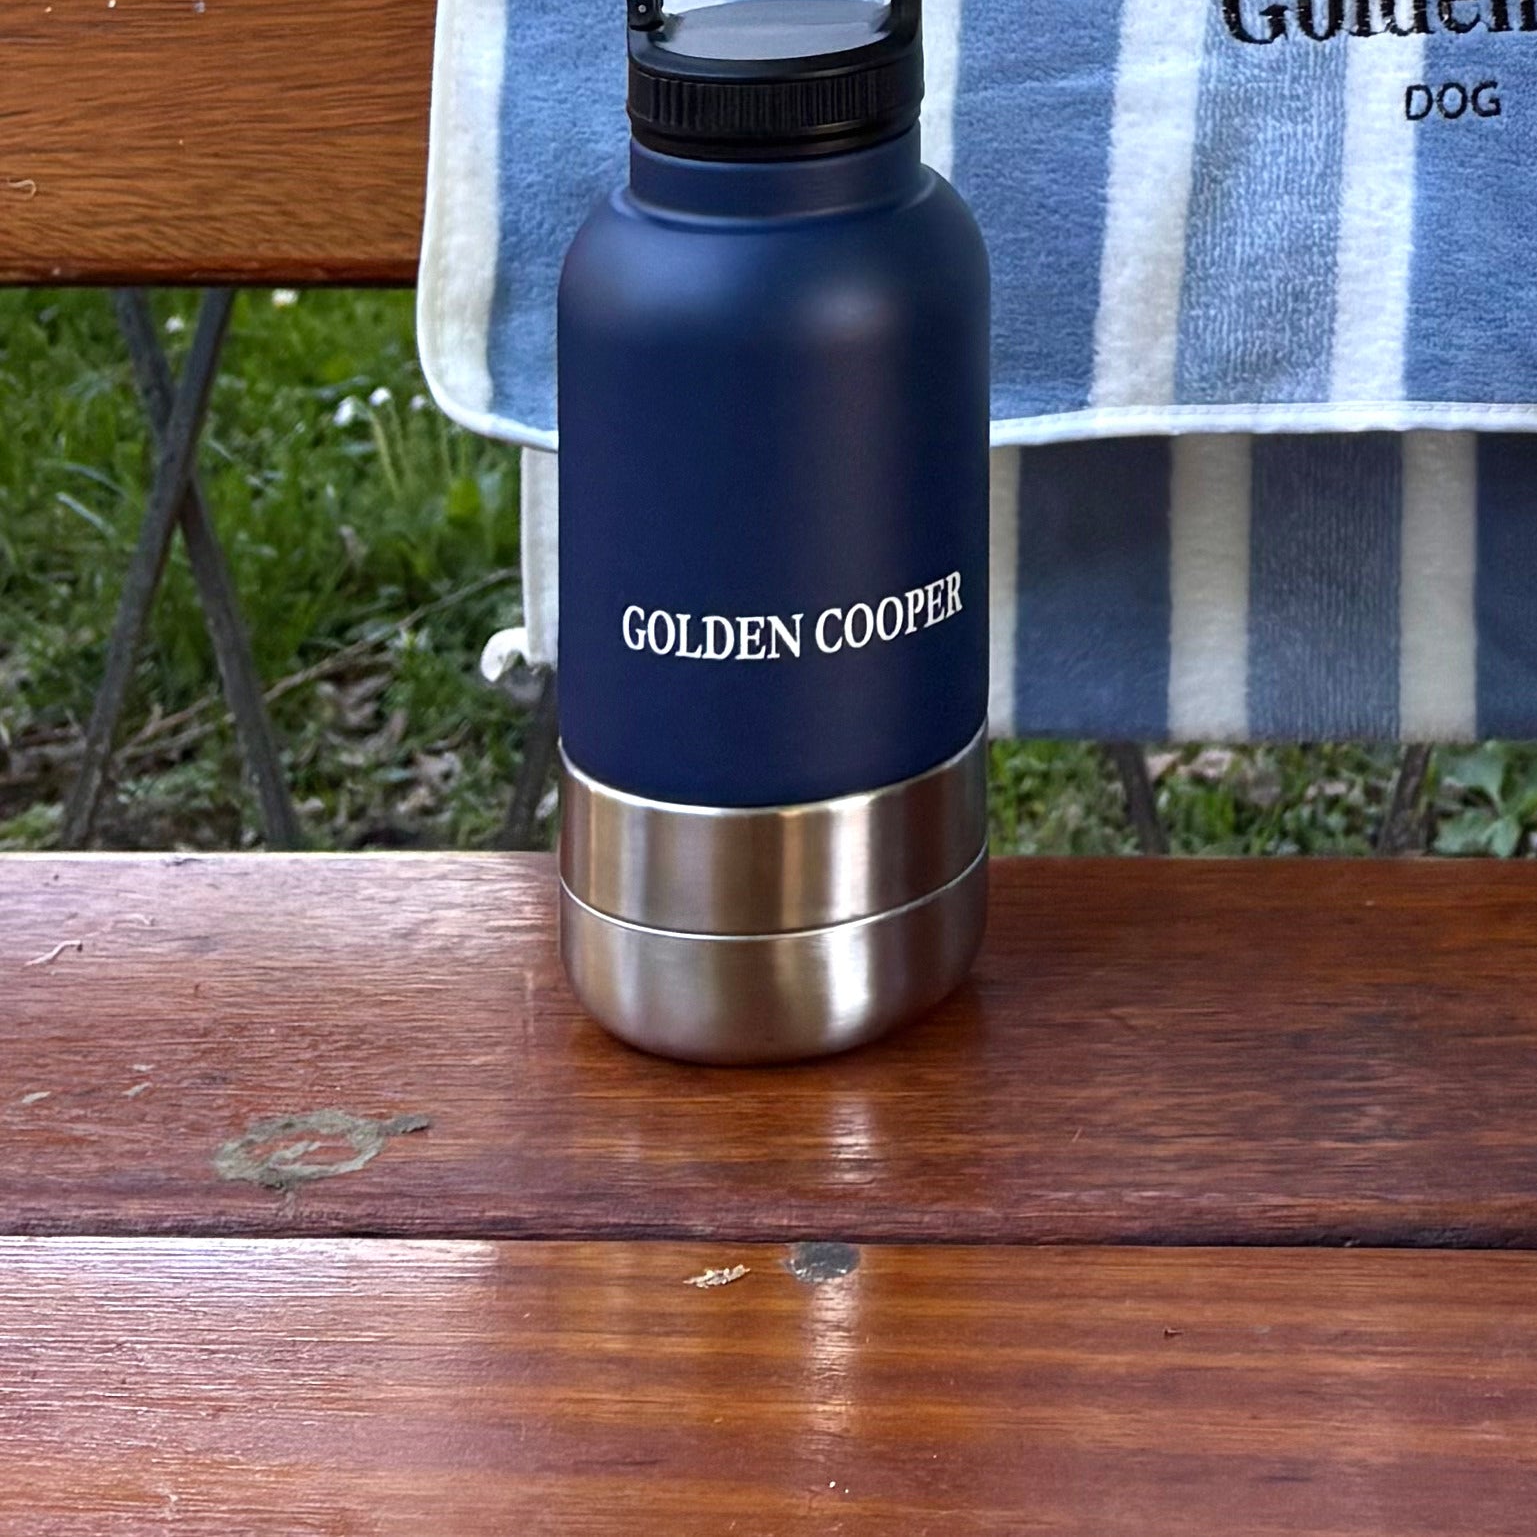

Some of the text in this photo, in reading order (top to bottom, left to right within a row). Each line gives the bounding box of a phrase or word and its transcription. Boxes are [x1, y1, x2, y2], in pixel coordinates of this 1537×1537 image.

[1404, 79, 1502, 121] DOG
[622, 570, 963, 660] GOLDEN COOPER
